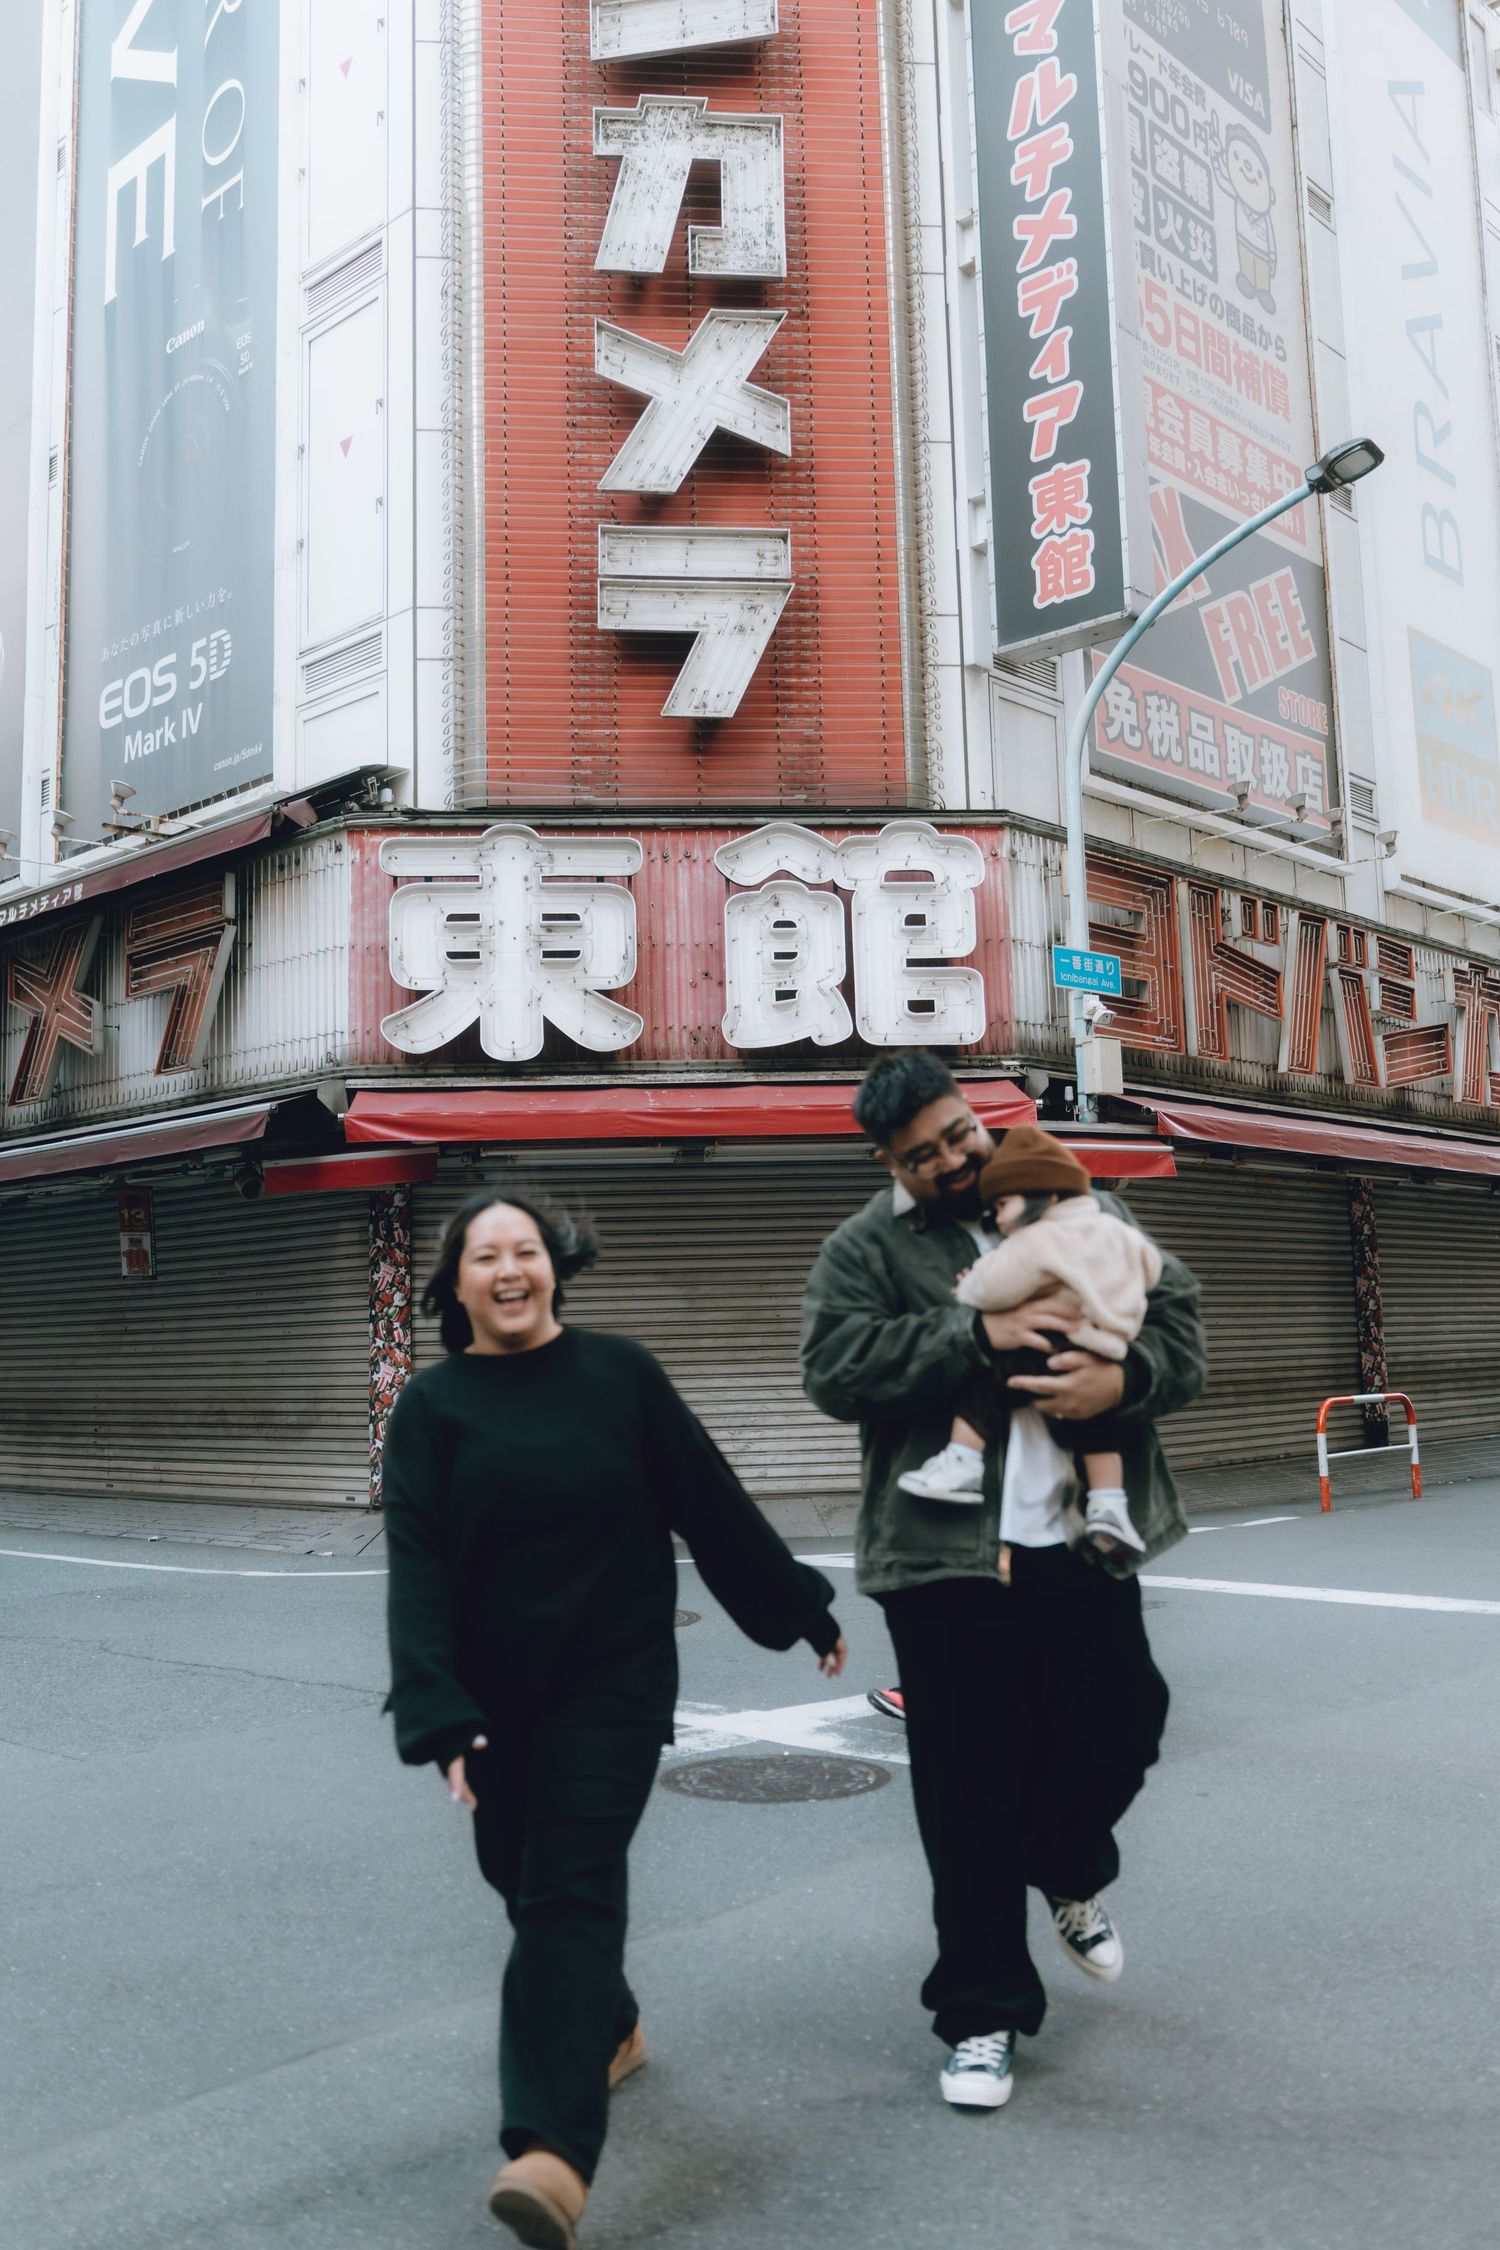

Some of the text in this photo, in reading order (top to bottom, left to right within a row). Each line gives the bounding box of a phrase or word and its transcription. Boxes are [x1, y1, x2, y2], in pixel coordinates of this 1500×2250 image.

[1124, 23, 1207, 112] レード年会費
[1226, 64, 1266, 119] VISA
[1157, 199, 1214, 273] 火災
[165, 320, 205, 355] Canon
[1004, 0, 1096, 610] マルチメディア東館
[1136, 240, 1288, 362] 買い上げの商品から
[1387, 80, 1464, 588] BRAVIA
[1137, 274, 1291, 424] 5日間補償
[100, 587, 232, 662] あなたの写真に新しい力を。
[1199, 566, 1317, 706] FREE
[99, 629, 232, 729] EOS 5D
[1278, 686, 1329, 736] STORE
[124, 702, 204, 764] Mark IV
[1102, 676, 1324, 815] 免税品取扱店
[1425, 750, 1500, 835] HDR
[379, 822, 986, 1062] 東館
[1060, 955, 1115, 976] 一番街通り
[1060, 971, 1099, 987] Ichibangai
[7, 870, 236, 1107] メラ
